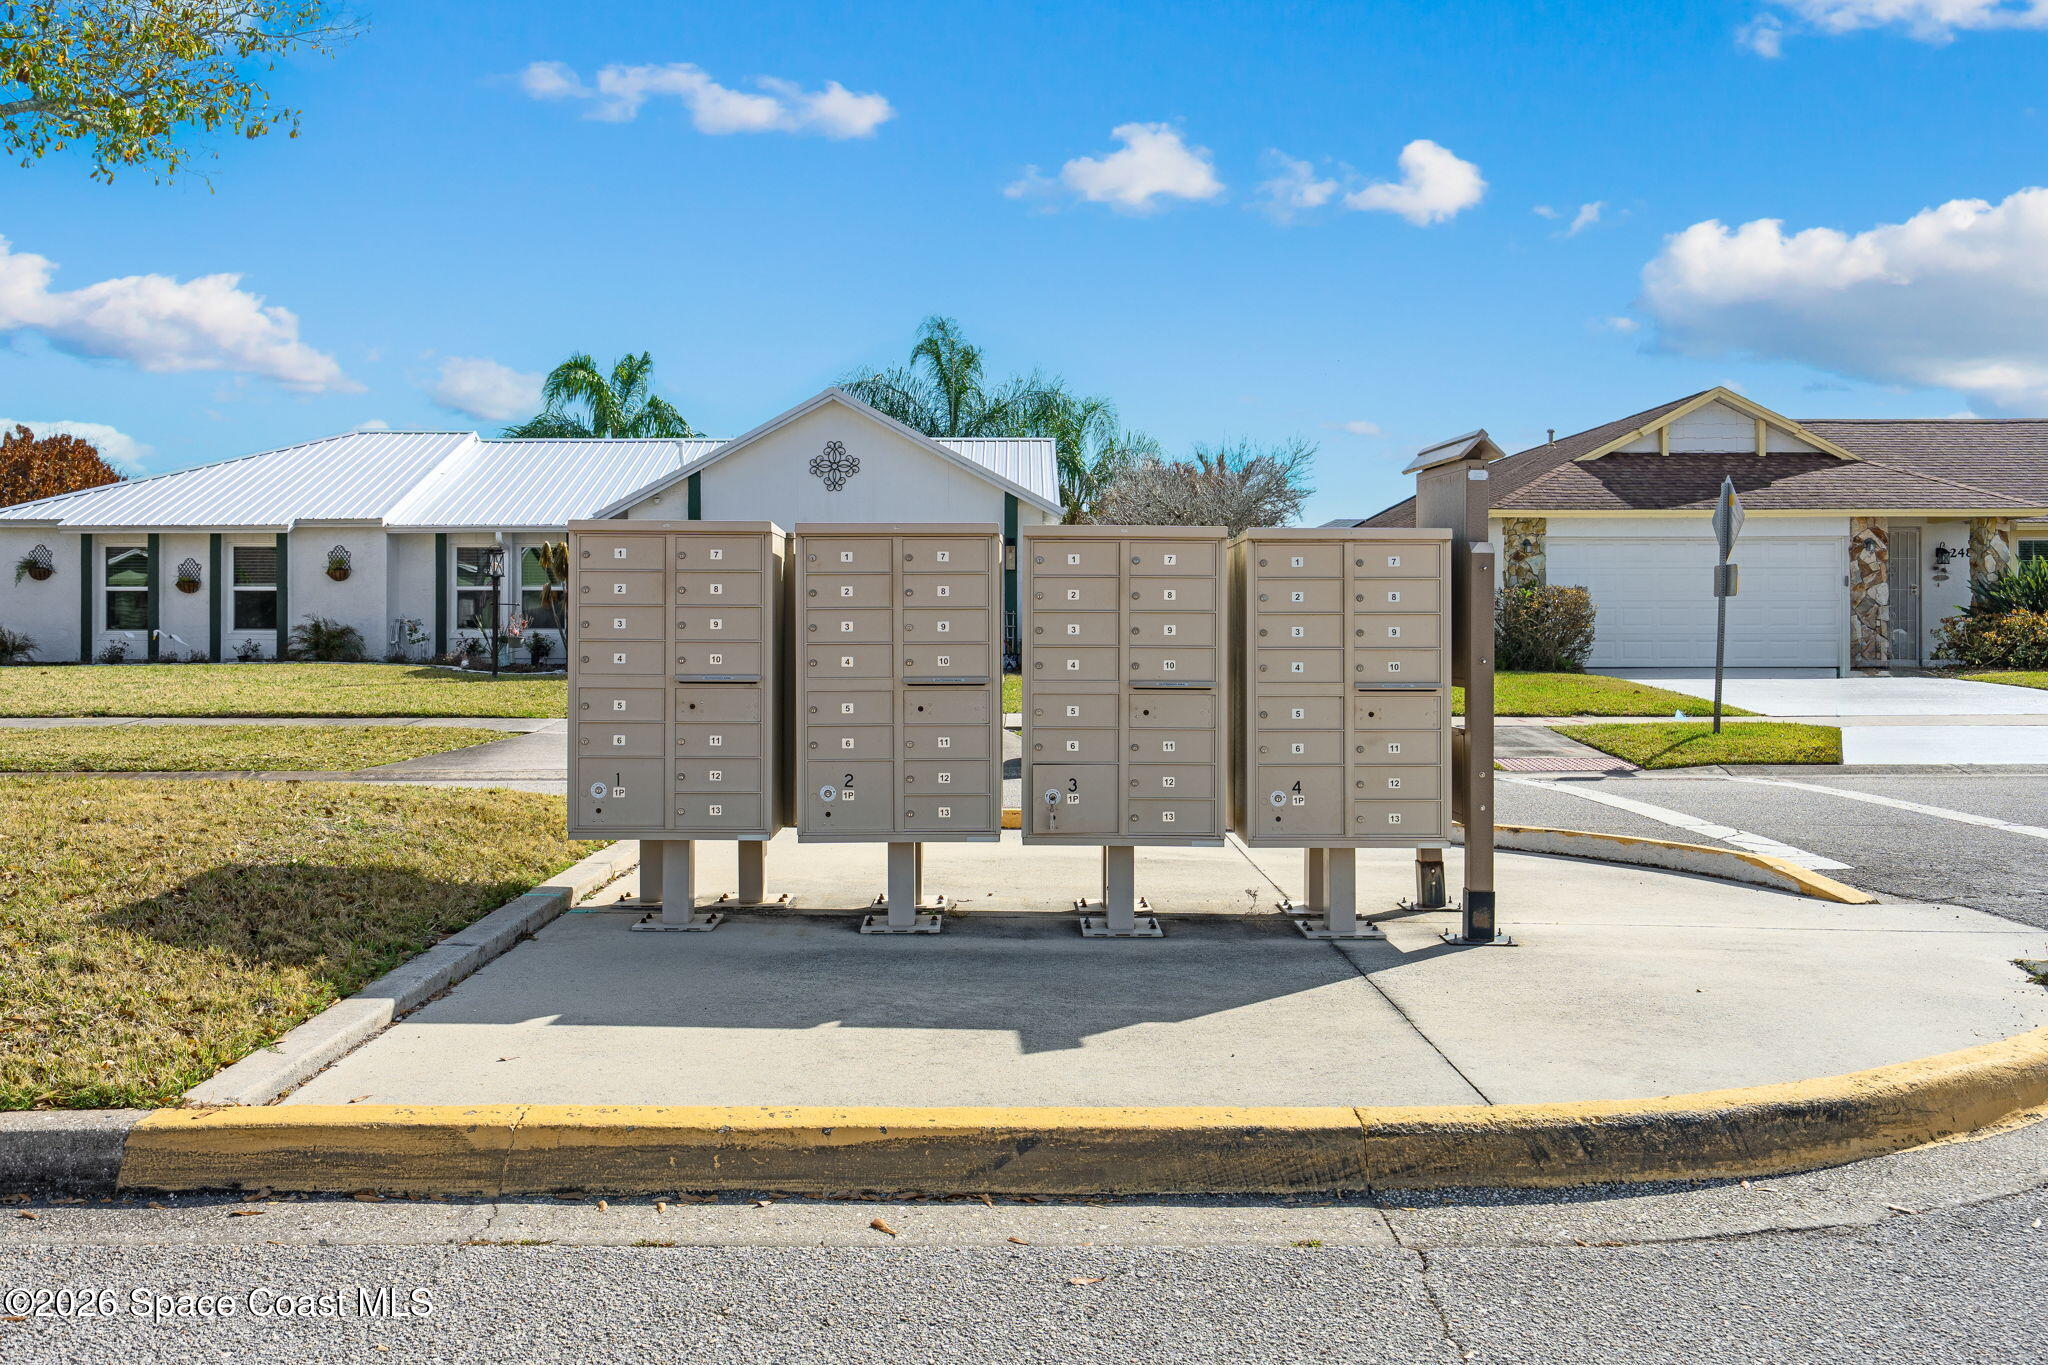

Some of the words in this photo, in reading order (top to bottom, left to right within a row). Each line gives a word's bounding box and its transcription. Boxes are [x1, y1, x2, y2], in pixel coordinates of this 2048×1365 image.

[1165, 662, 1174, 670] 10
[1164, 742, 1174, 750] 11
[844, 774, 854, 788] 2
[1068, 778, 1078, 792] 3
[1292, 780, 1302, 794] 4
[614, 788, 624, 796] 1P
[1294, 796, 1304, 804] 1P
[711, 806, 720, 814] 13
[940, 808, 950, 816] 13
